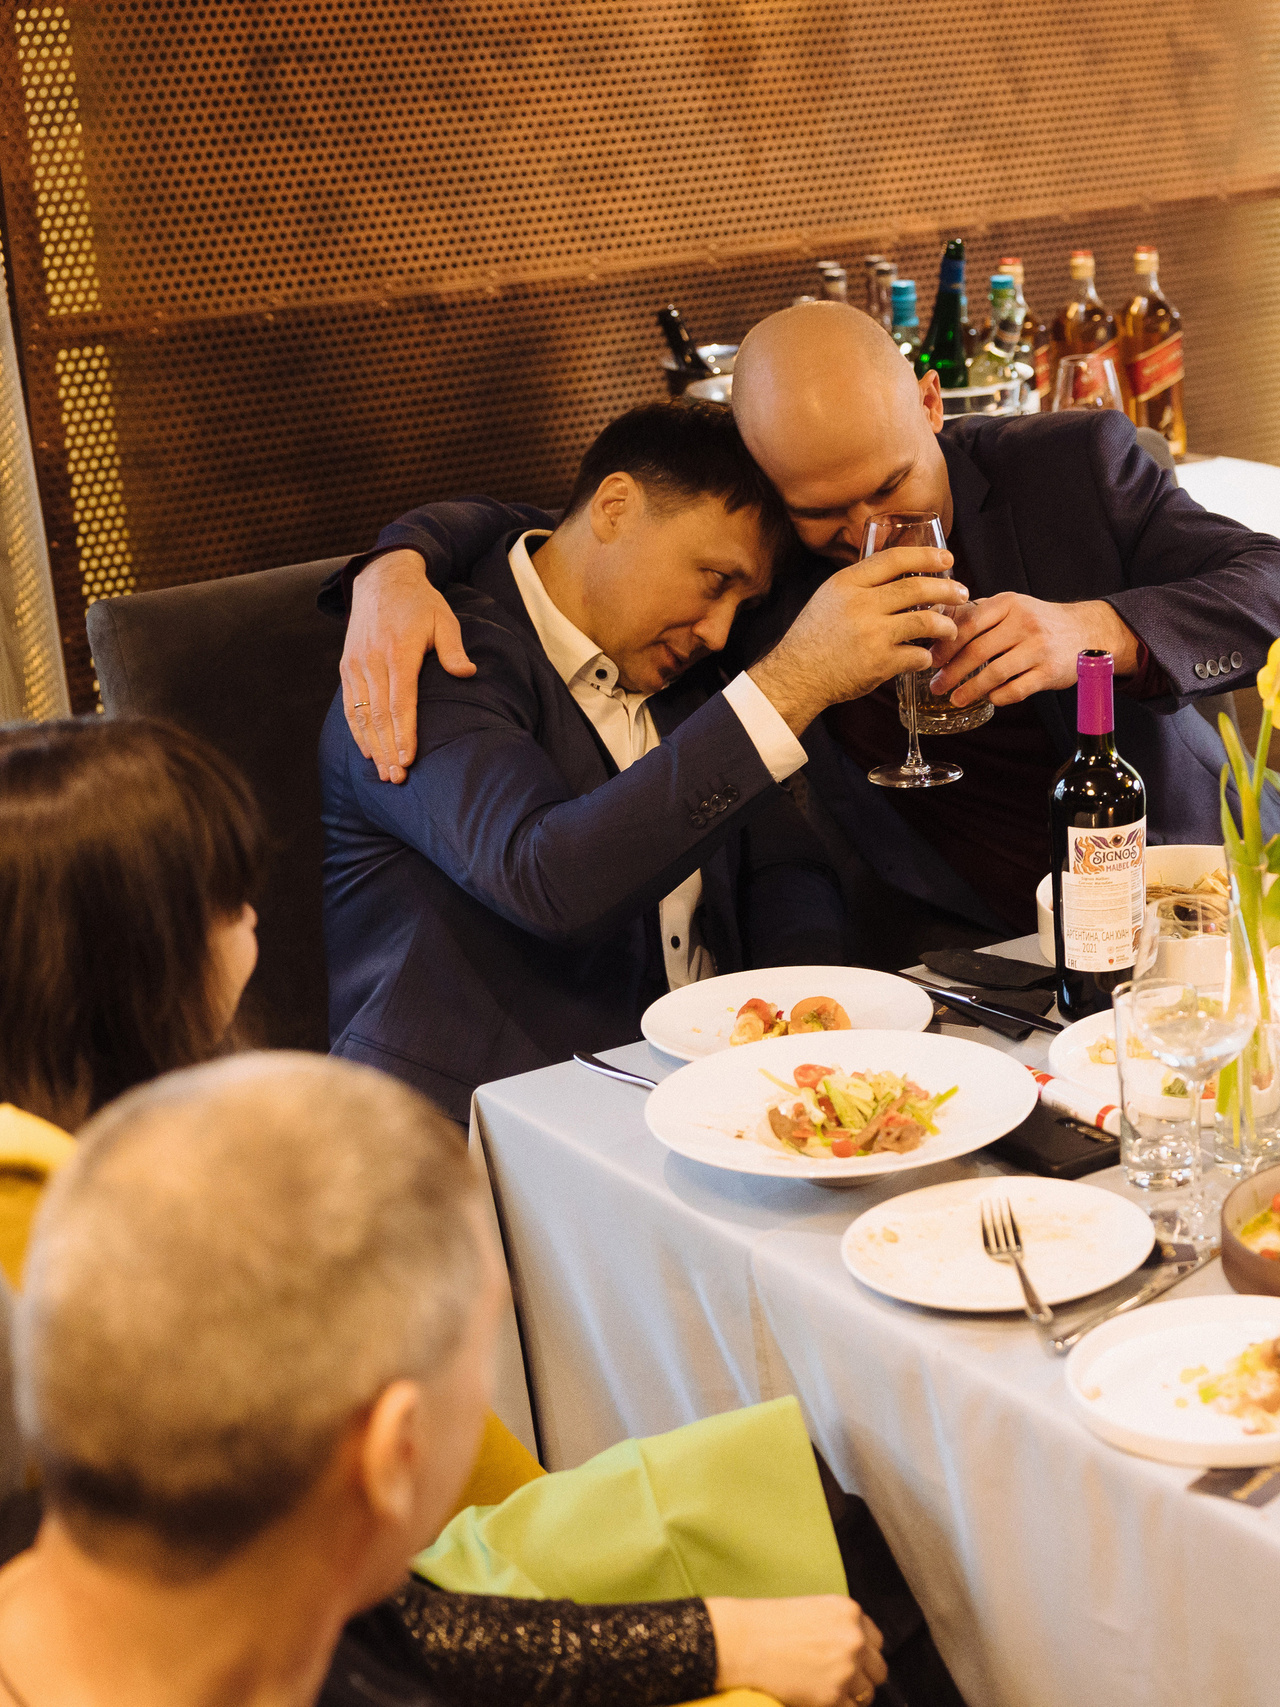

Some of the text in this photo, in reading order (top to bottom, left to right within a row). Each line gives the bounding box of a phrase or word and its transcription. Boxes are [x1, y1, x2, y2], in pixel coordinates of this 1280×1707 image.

[1092, 845, 1138, 865] SIGNOS
[1101, 931, 1114, 942] САН
[1082, 942, 1097, 954] 2021
